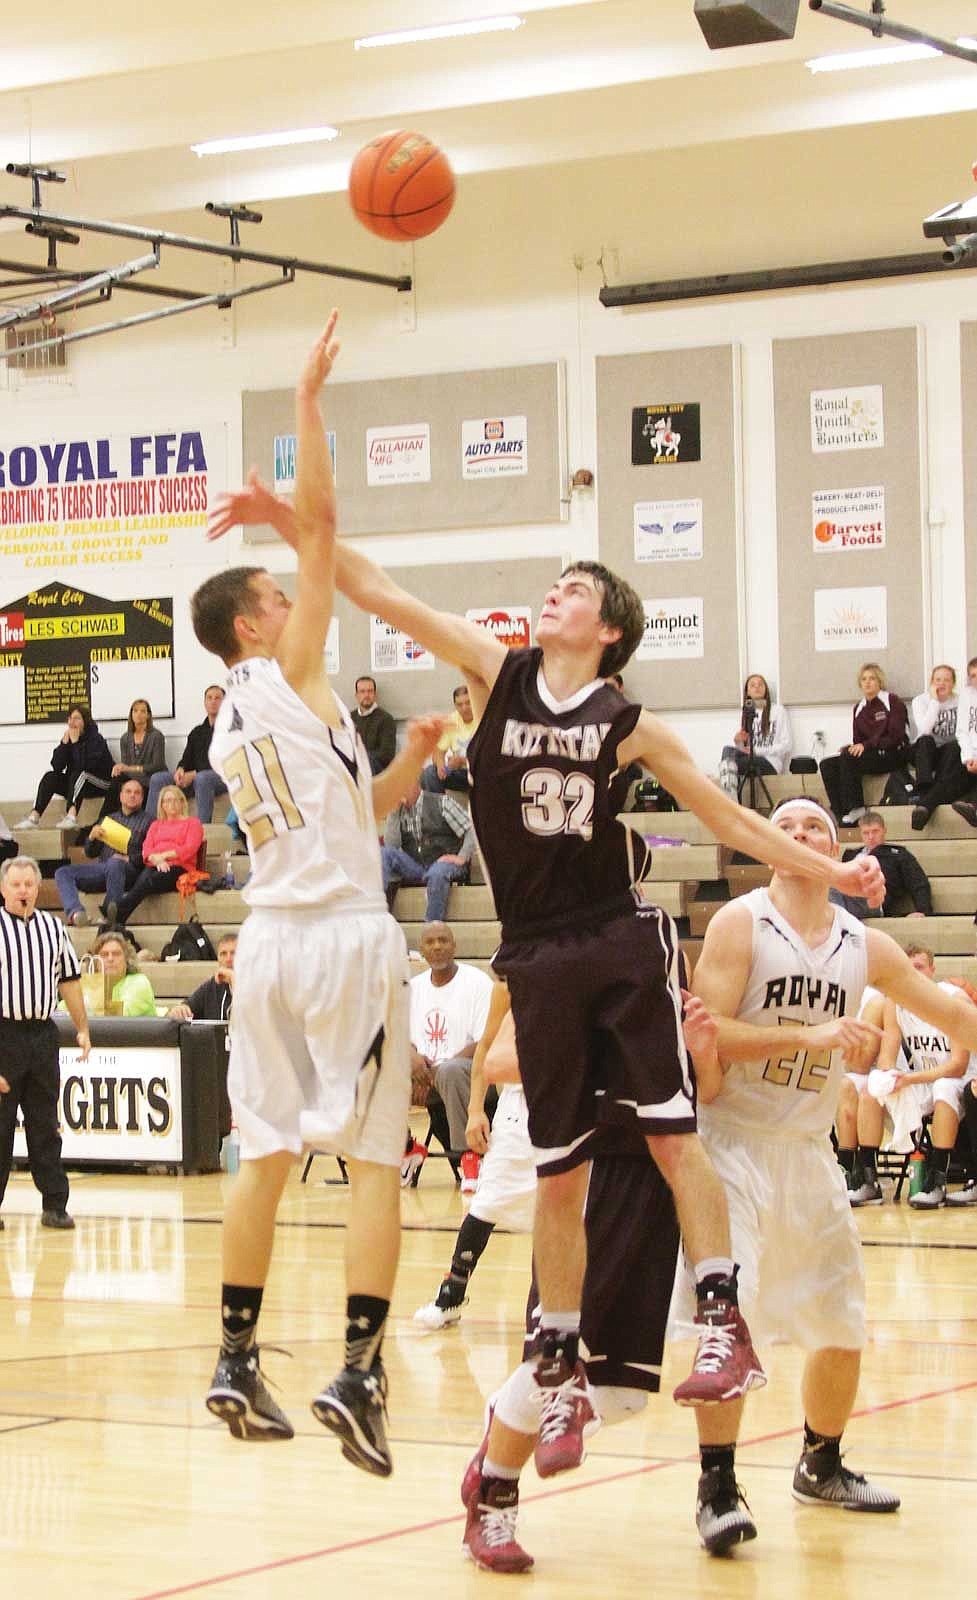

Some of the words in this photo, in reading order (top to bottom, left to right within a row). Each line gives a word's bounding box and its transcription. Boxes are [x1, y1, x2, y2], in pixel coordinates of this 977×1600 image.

[815, 396, 848, 413] Royal
[815, 415, 851, 431] Youth
[816, 431, 878, 446] Boosters
[465, 443, 492, 457] AUTO
[494, 440, 523, 454] PARTS
[0, 439, 118, 488] OYAL
[130, 431, 208, 477] FFA
[0, 487, 44, 526] BRATING
[47, 487, 59, 522] 75
[61, 483, 93, 520] YEARS
[95, 483, 108, 519] OF
[110, 480, 157, 517] STUDENT
[159, 475, 208, 513] SUCCESS
[64, 518, 121, 535] PREMIER
[125, 512, 209, 532] LEADERSHIP
[827, 521, 882, 535] Harvest
[72, 535, 131, 550] GROWTH
[139, 533, 169, 545] AND
[842, 534, 882, 546] Foods
[24, 553, 78, 568] CAREER
[82, 549, 143, 563] SUCCESS
[27, 591, 59, 607] Royal
[62, 590, 85, 606] City
[30, 621, 55, 636] LES
[61, 618, 119, 635] SCHWAB
[90, 648, 121, 663] GIRLS
[126, 645, 170, 661] VARSITY
[223, 734, 305, 852] 21
[520, 767, 595, 841] 32
[58, 1075, 171, 1135] GHTS
